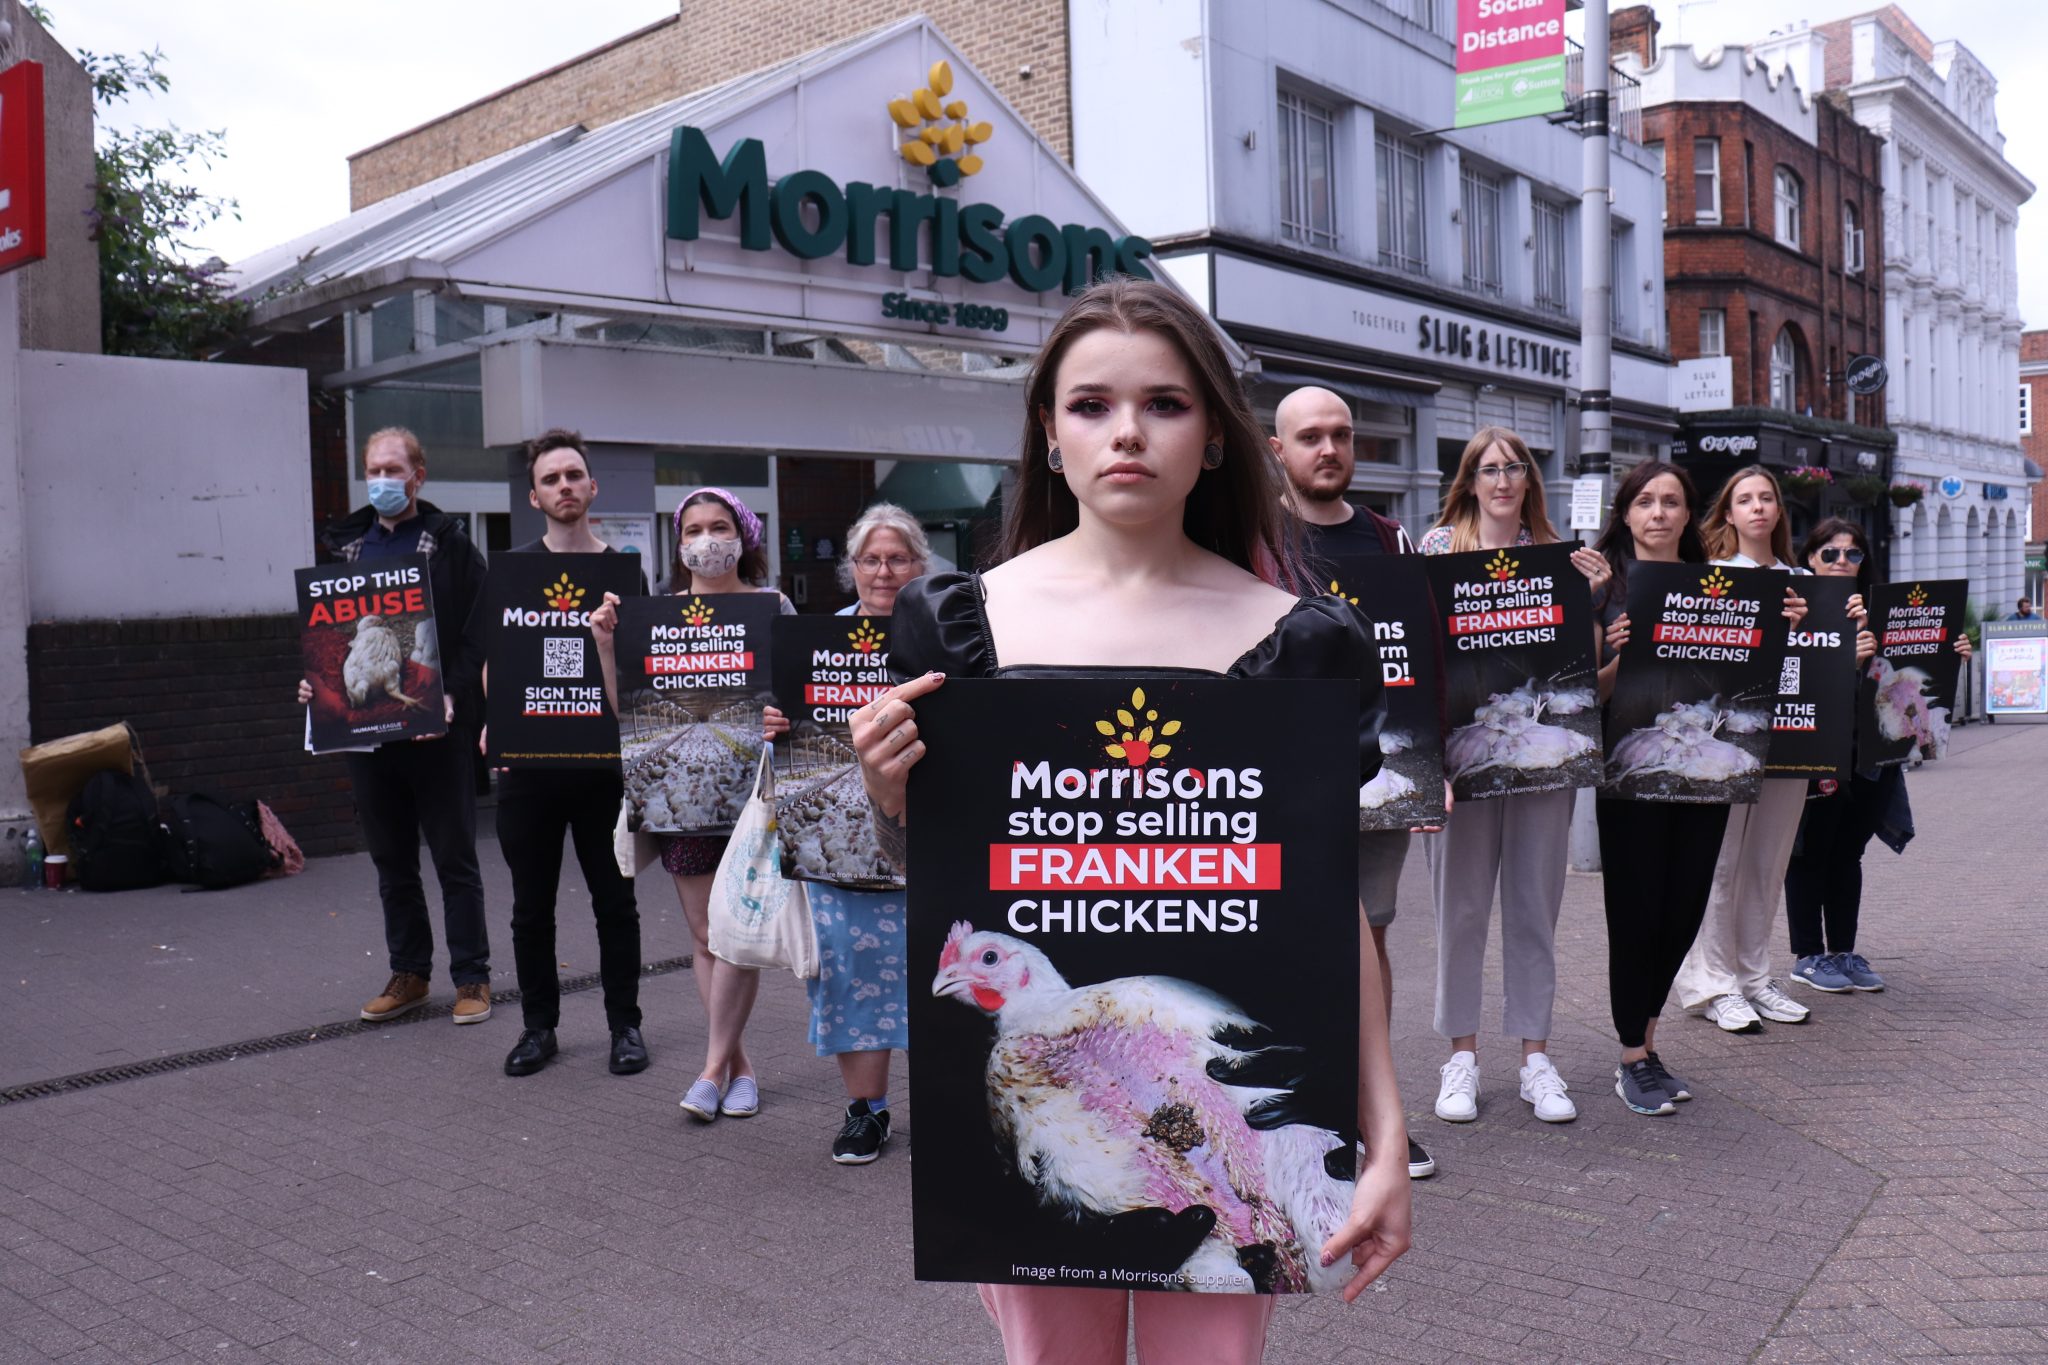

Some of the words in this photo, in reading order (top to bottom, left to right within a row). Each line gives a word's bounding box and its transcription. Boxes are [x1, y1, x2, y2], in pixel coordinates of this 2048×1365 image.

[1463, 19, 1560, 53] Distance
[667, 125, 1154, 297] Morrisons
[881, 292, 950, 326] Since
[955, 301, 1009, 333] 1899
[1352, 310, 1407, 334] TOGETHER
[1419, 314, 1472, 359] SLUG
[1478, 329, 1490, 363] &
[1496, 332, 1573, 380] LETTUCE
[1693, 371, 1716, 381] SLUG
[1684, 389, 1725, 400] LETTUCE
[308, 575, 366, 598] STOP
[371, 567, 421, 589] THIS
[1454, 576, 1554, 599] Morrisons
[308, 587, 425, 627] ABUSE
[1454, 598, 1492, 614] stop
[1496, 592, 1553, 609] selling
[1664, 592, 1760, 613] Morrisons
[1889, 605, 1946, 618] Morrisons
[502, 607, 592, 627] Morriso
[1456, 607, 1553, 632] FRANKEN
[1662, 610, 1698, 627] stop
[1701, 610, 1756, 629] selling
[1887, 618, 1907, 630] stop
[1908, 616, 1943, 629] selling
[651, 623, 746, 641] Morrisons
[1659, 625, 1753, 645] FRANKEN
[1884, 628, 1941, 644] FRANKEN
[2014, 623, 2047, 631] LETTUCE
[650, 640, 688, 656] stop
[690, 637, 745, 654] selling
[1457, 627, 1556, 651] CHICKENS!
[812, 650, 888, 667] Morriso
[1656, 644, 1750, 663] CHICKENS!
[1883, 643, 1939, 657] CHICKENS!
[652, 653, 746, 672] FRANKEN
[652, 672, 747, 690] CHICKENS!
[812, 669, 852, 685] stop
[857, 667, 890, 683] sell
[525, 686, 565, 700] SIGN
[568, 686, 602, 700] THE
[813, 685, 894, 704] FRANK
[525, 700, 602, 715] PETITION
[1785, 703, 1816, 716] THE
[1773, 716, 1815, 729] ITION
[1010, 760, 1263, 799] Morrisons
[1471, 790, 1490, 799] Image
[1489, 789, 1505, 798] from
[1511, 785, 1541, 795] Morrisons
[1008, 807, 1104, 844] stop
[1115, 802, 1257, 844] selling
[1010, 847, 1256, 885] FRANKEN
[1007, 898, 1259, 933] CHICKENS!
[1011, 1263, 1056, 1281] Image
[1059, 1264, 1095, 1280] from
[1098, 1270, 1107, 1280] a
[1111, 1267, 1185, 1285] Morrisons
[1188, 1271, 1249, 1288] supplier
